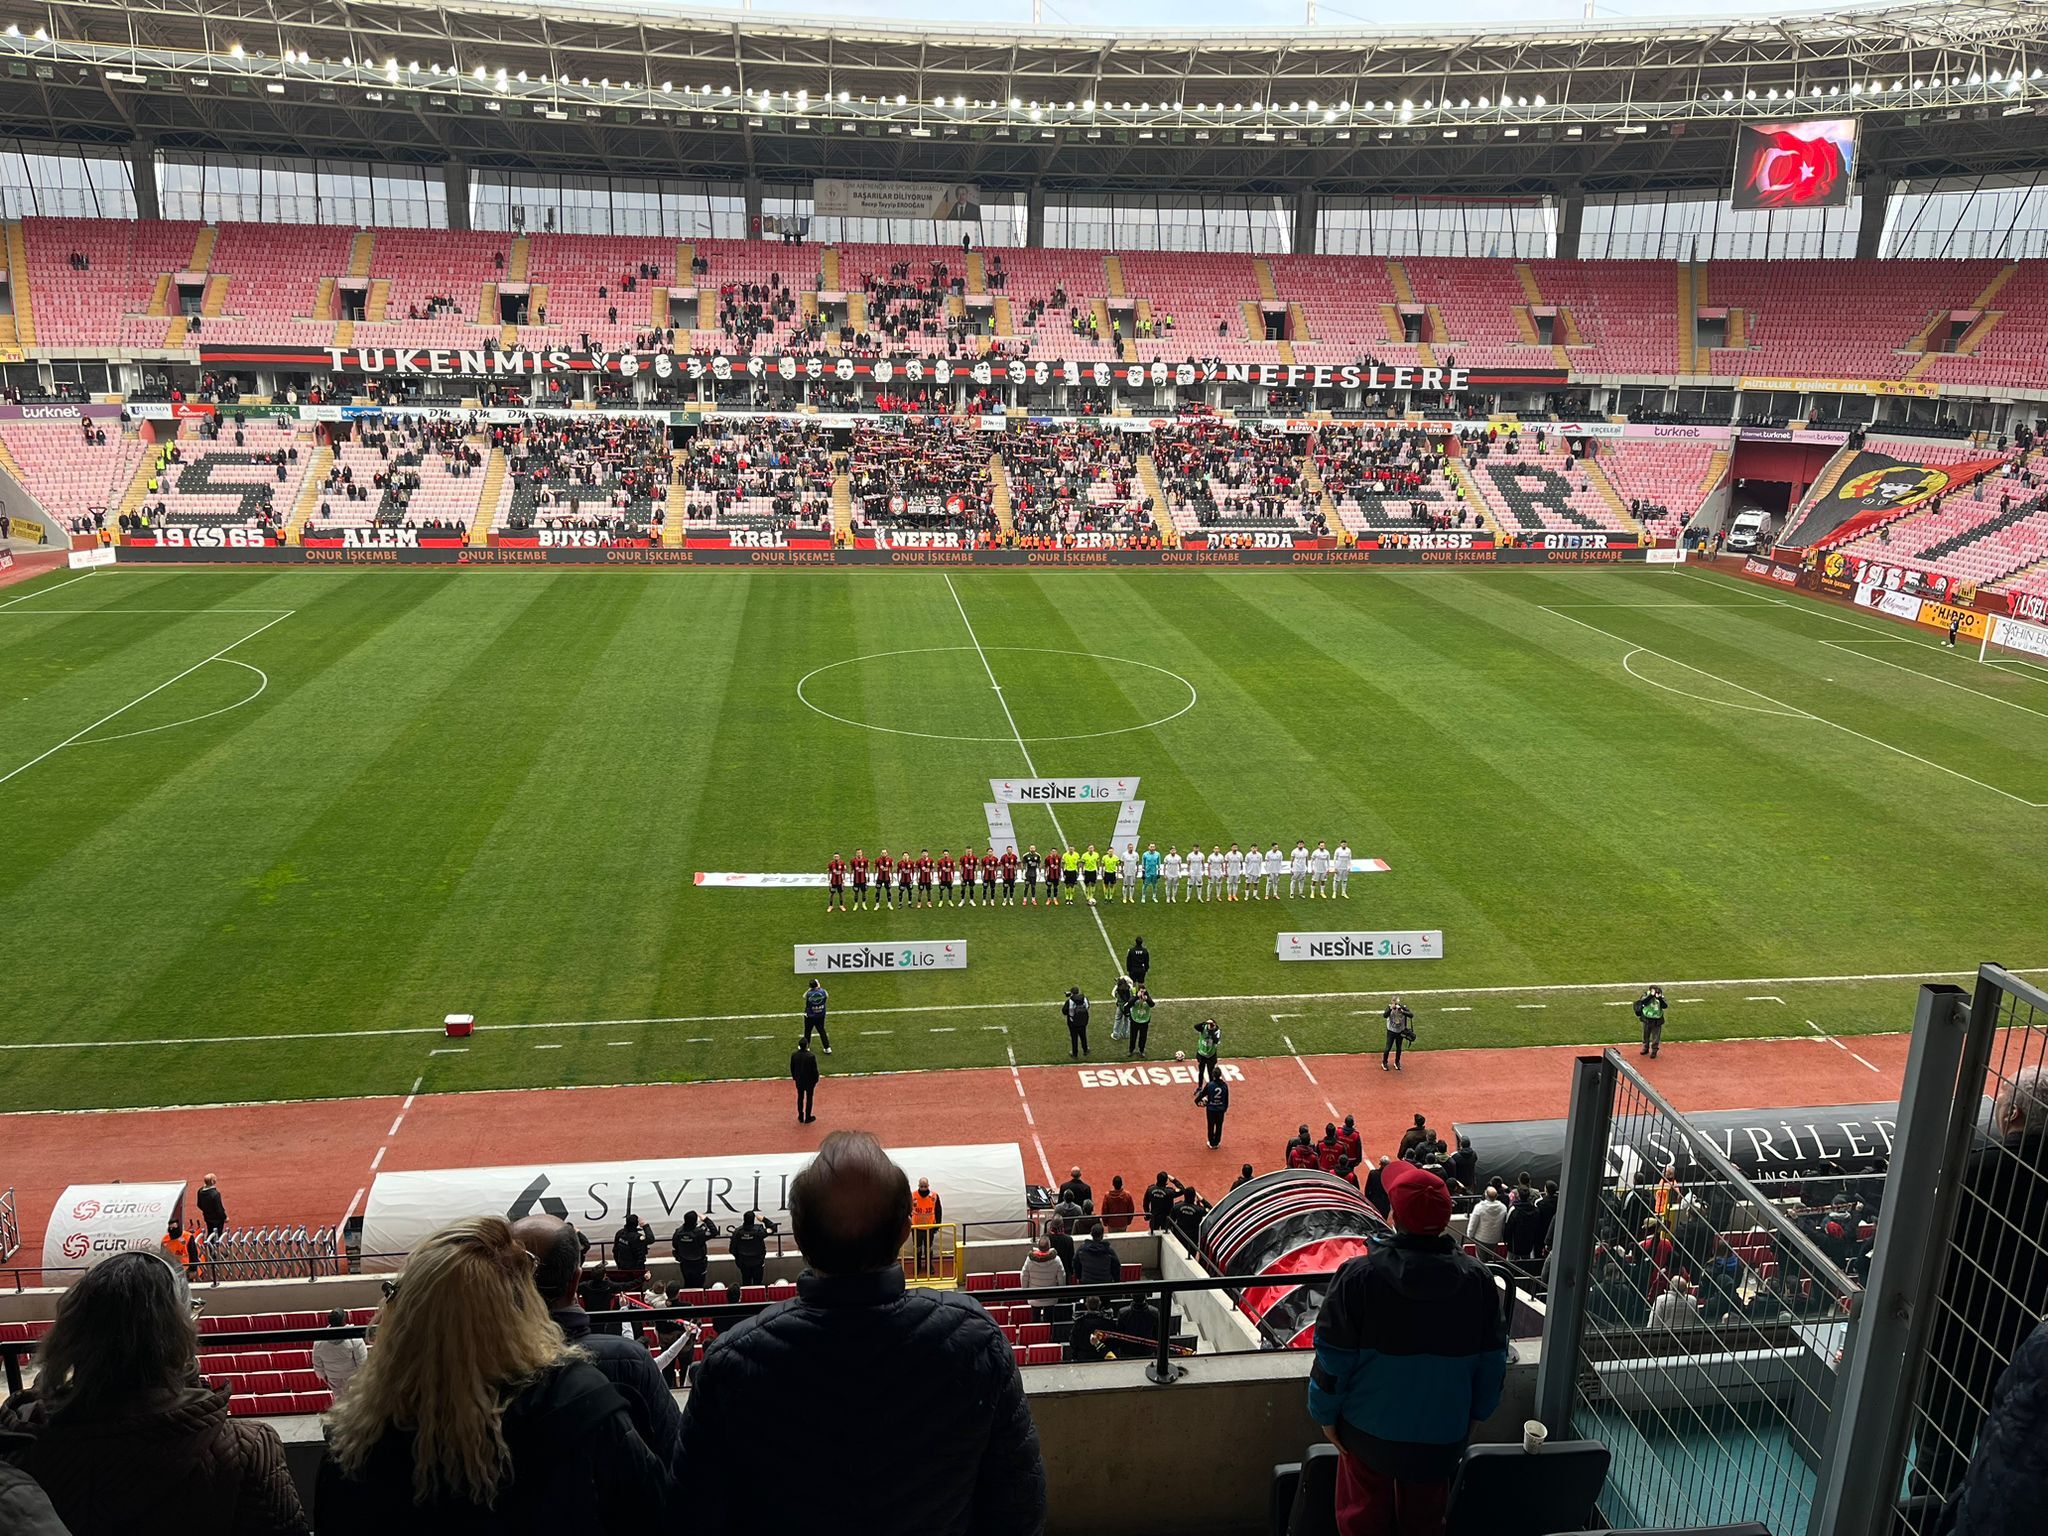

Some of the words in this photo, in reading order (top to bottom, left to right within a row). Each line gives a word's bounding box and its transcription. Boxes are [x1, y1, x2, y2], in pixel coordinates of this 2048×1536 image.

[853, 192, 893, 200] BAŞARILAR
[1225, 364, 1471, 391] NEFESLERE
[1743, 379, 1792, 389] MUTLULUK
[22, 405, 81, 418] turknet
[1654, 426, 1700, 437] turknet
[1763, 431, 1791, 439] turknet
[1816, 433, 1845, 441] turknet
[342, 529, 419, 547] ALEM
[538, 530, 611, 547] BUYSA
[891, 531, 959, 548] NEFER
[1207, 532, 1295, 548] DIRDA
[1384, 533, 1473, 549] HRKESE
[306, 550, 342, 560] ONUR
[347, 549, 397, 562] İŞKEMBE
[458, 550, 494, 560] ONUR
[498, 549, 547, 562] İŞKEMBE
[607, 551, 641, 561] ONUR
[645, 549, 693, 563] İŞKEMBE
[751, 551, 786, 561] ONUR
[892, 552, 926, 562] ONUR
[928, 551, 973, 563] İŞKEMBE
[1028, 552, 1061, 562] ONUR
[1064, 551, 1108, 564] İŞKEMBE
[1161, 552, 1195, 562] ONUR
[1196, 551, 1240, 563] İŞKEMBE
[1293, 552, 1326, 561] ONUR
[1327, 550, 1370, 563] İŞKEMBE
[1421, 551, 1453, 561] ONUR
[1455, 549, 1497, 562] İŞKEMBE
[1548, 551, 1579, 561] ONUR
[1581, 549, 1622, 562] İŞKEMBE
[1020, 782, 1076, 799] NESİNE
[1310, 936, 1374, 957] NESİNE
[827, 947, 894, 969] NESİNE
[1078, 1064, 1246, 1088] ESKİŞEHR
[1214, 1087, 1222, 1099] 2
